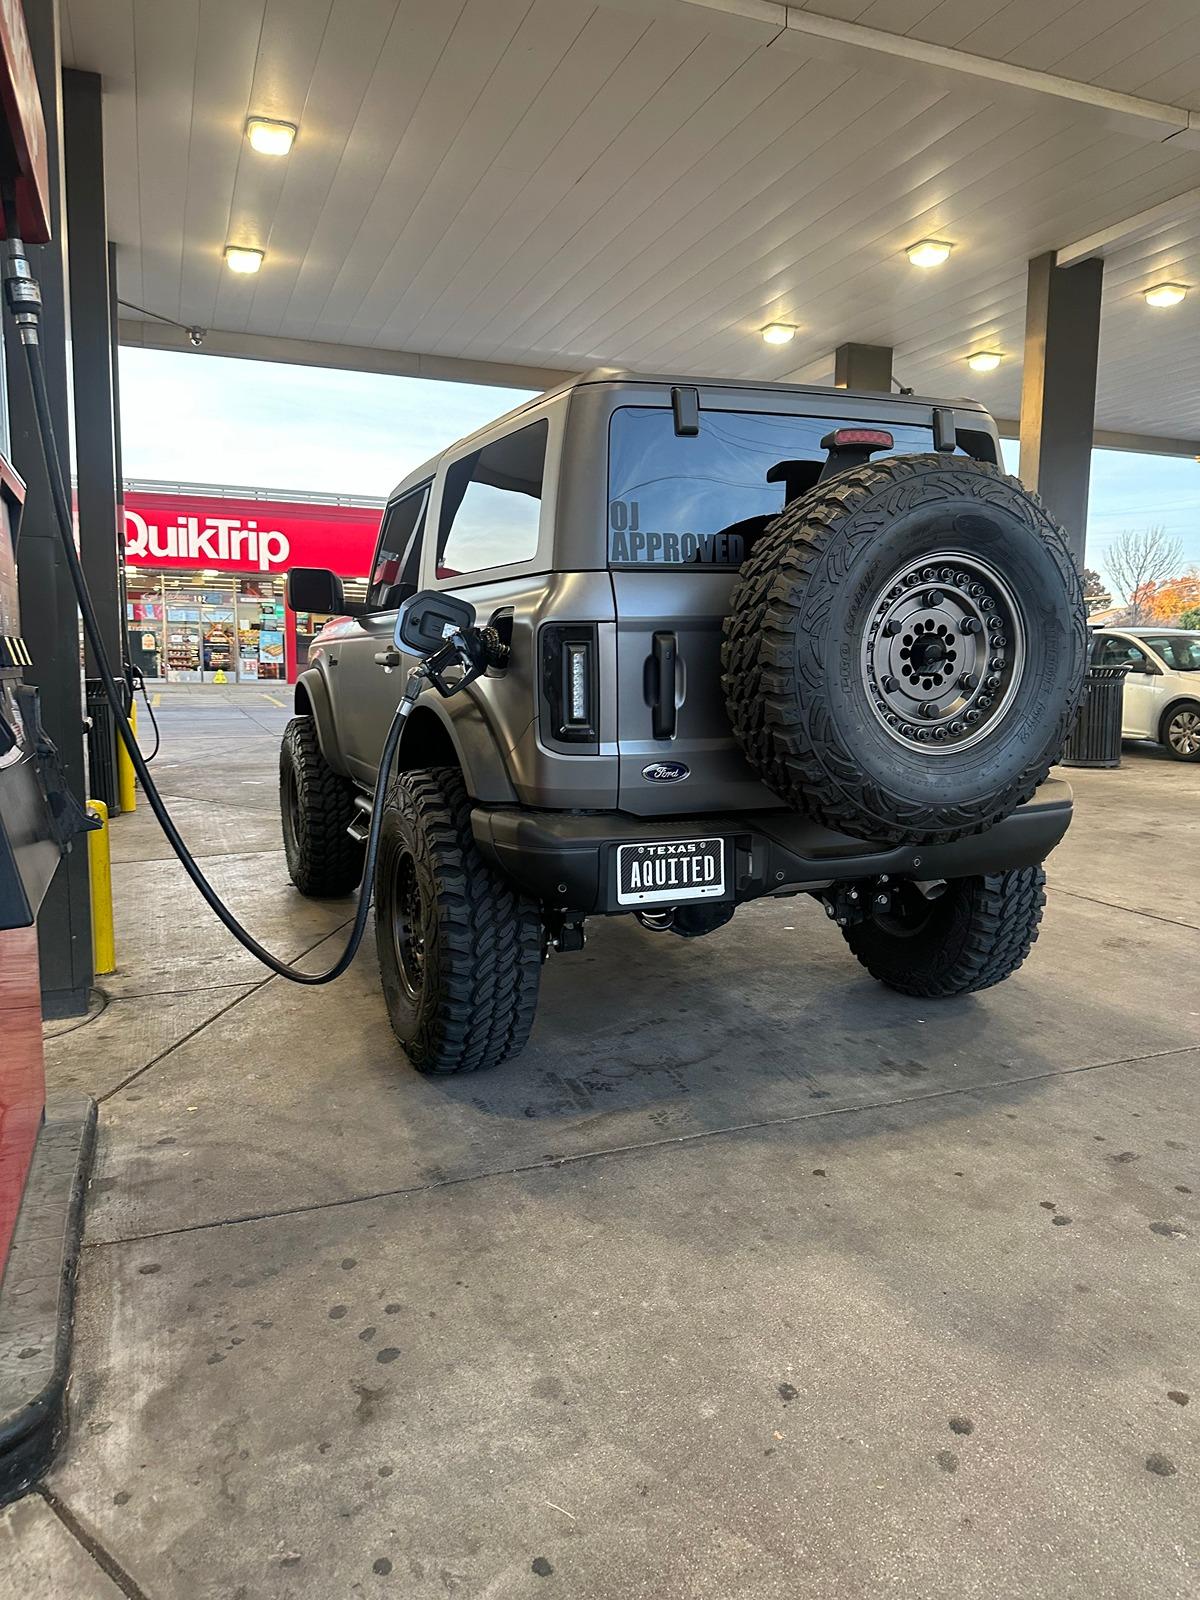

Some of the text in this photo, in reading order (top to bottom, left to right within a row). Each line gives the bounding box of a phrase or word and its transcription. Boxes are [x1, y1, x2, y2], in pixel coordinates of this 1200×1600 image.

[610, 501, 639, 531] OJ
[124, 510, 290, 571] QuikTrip
[611, 532, 744, 563] APPROVED
[654, 766, 679, 778] Ford
[647, 844, 696, 855] TEXAS
[630, 855, 715, 888] AQUITED
